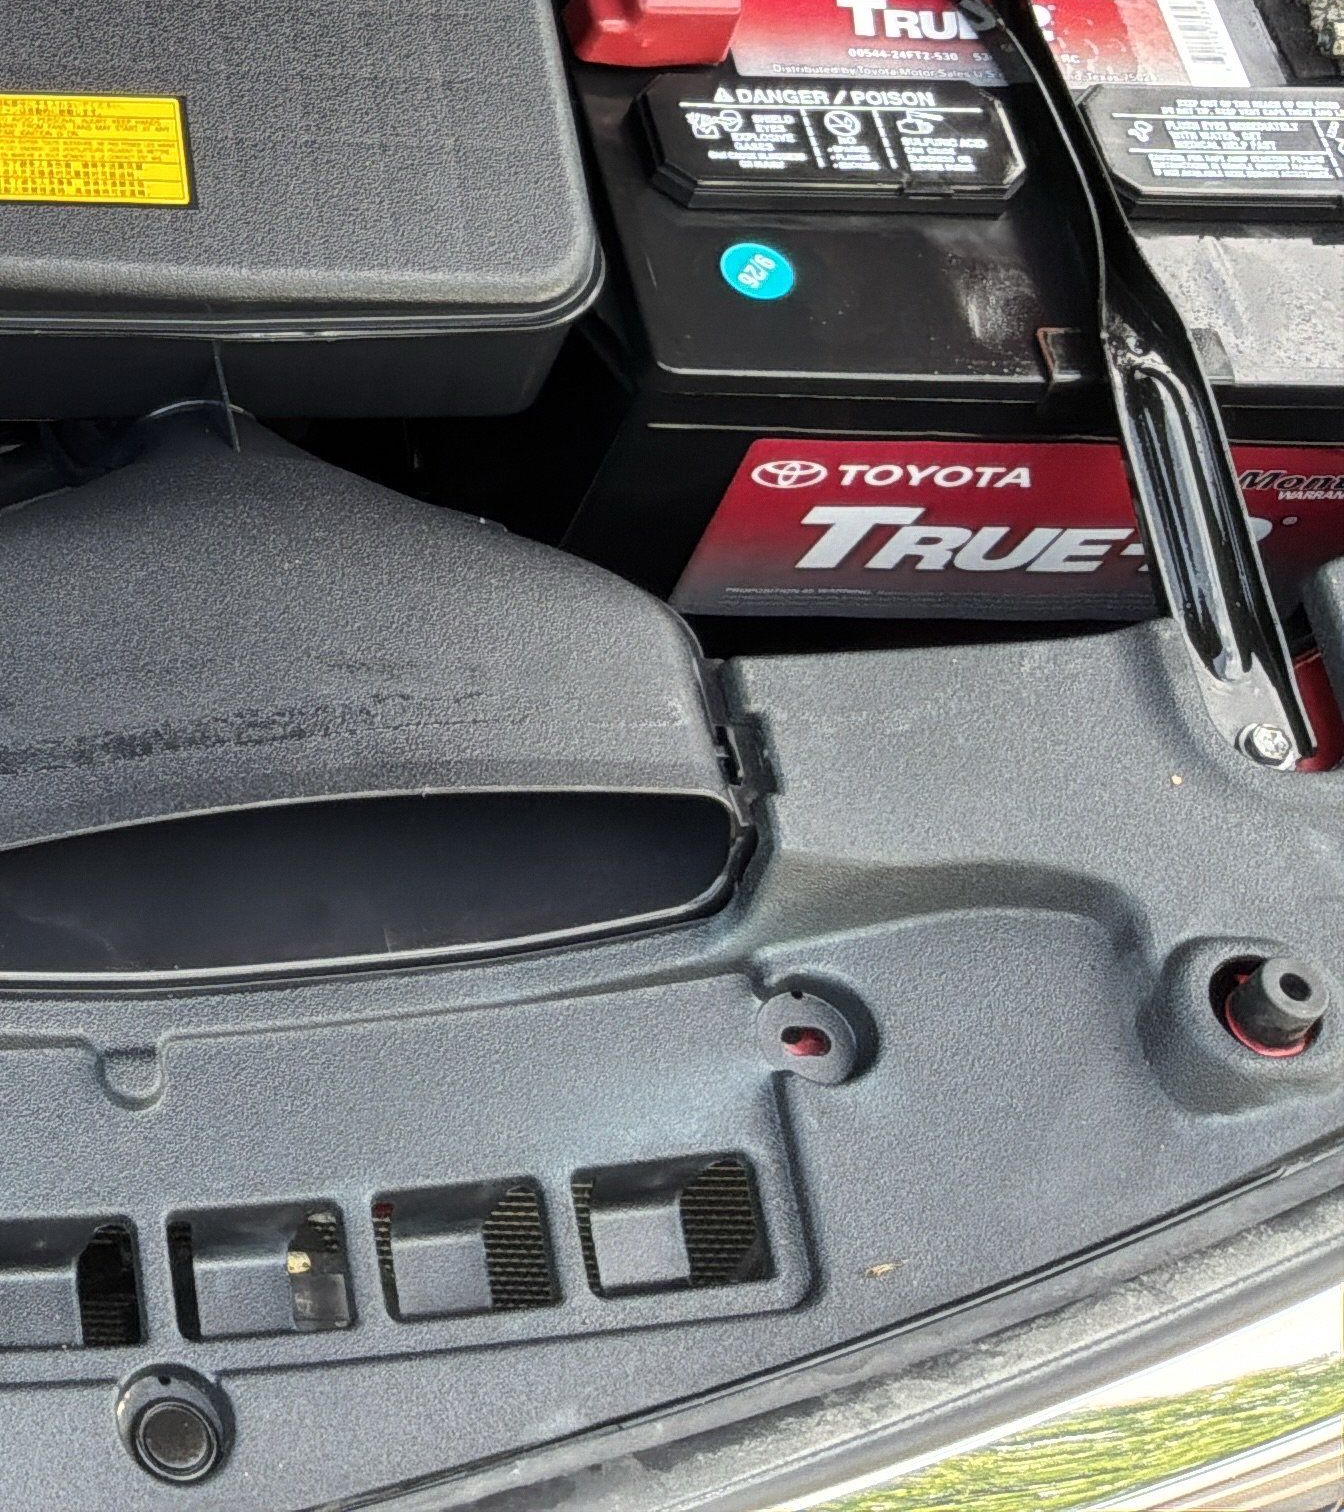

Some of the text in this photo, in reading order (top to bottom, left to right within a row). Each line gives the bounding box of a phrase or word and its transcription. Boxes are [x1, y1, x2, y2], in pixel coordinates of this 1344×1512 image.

[736, 88, 829, 105] DANGER
[850, 90, 937, 107] POISON
[839, 464, 1032, 489] TOYOTA
